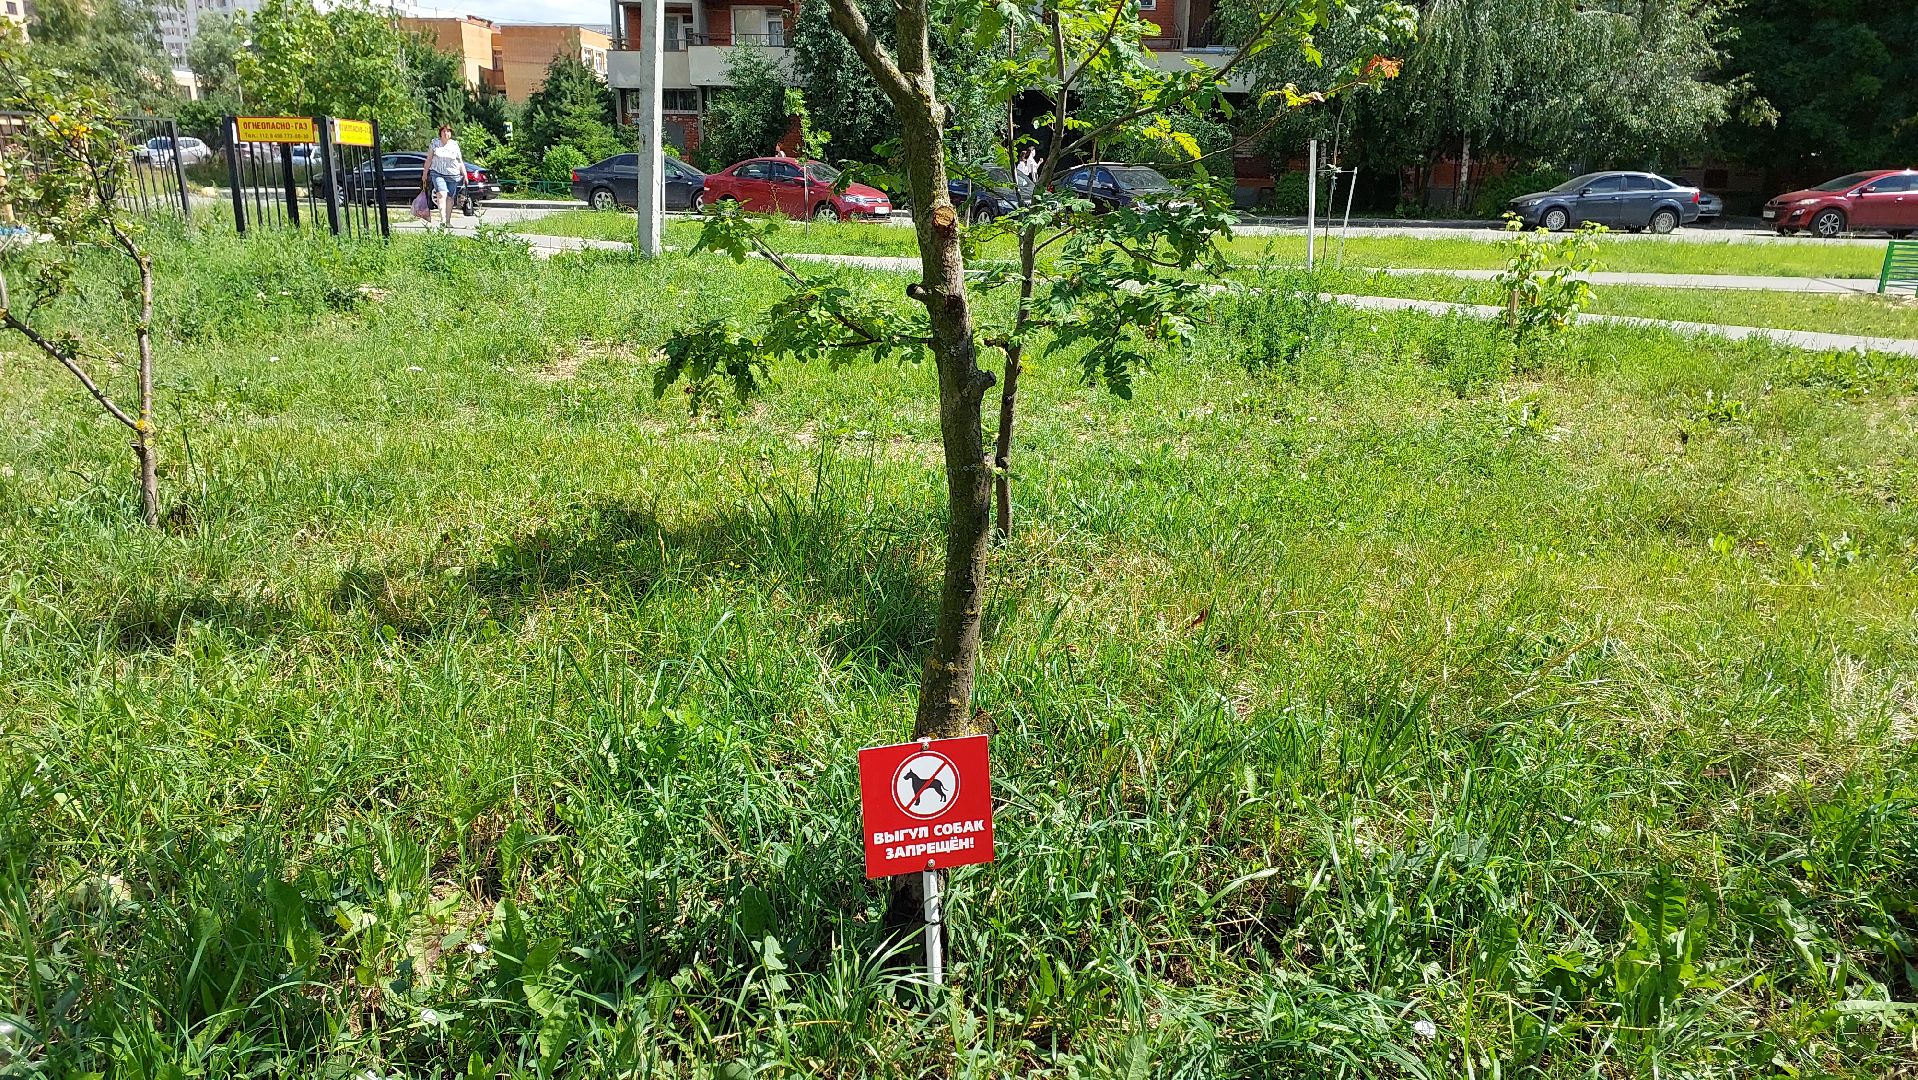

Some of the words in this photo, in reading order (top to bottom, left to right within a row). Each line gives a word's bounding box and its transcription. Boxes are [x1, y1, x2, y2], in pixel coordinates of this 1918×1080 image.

[873, 826, 929, 845] ВЫГУЛ
[933, 819, 985, 836] СОБАК
[885, 836, 975, 860] ЗАПРЕЩЁН!
